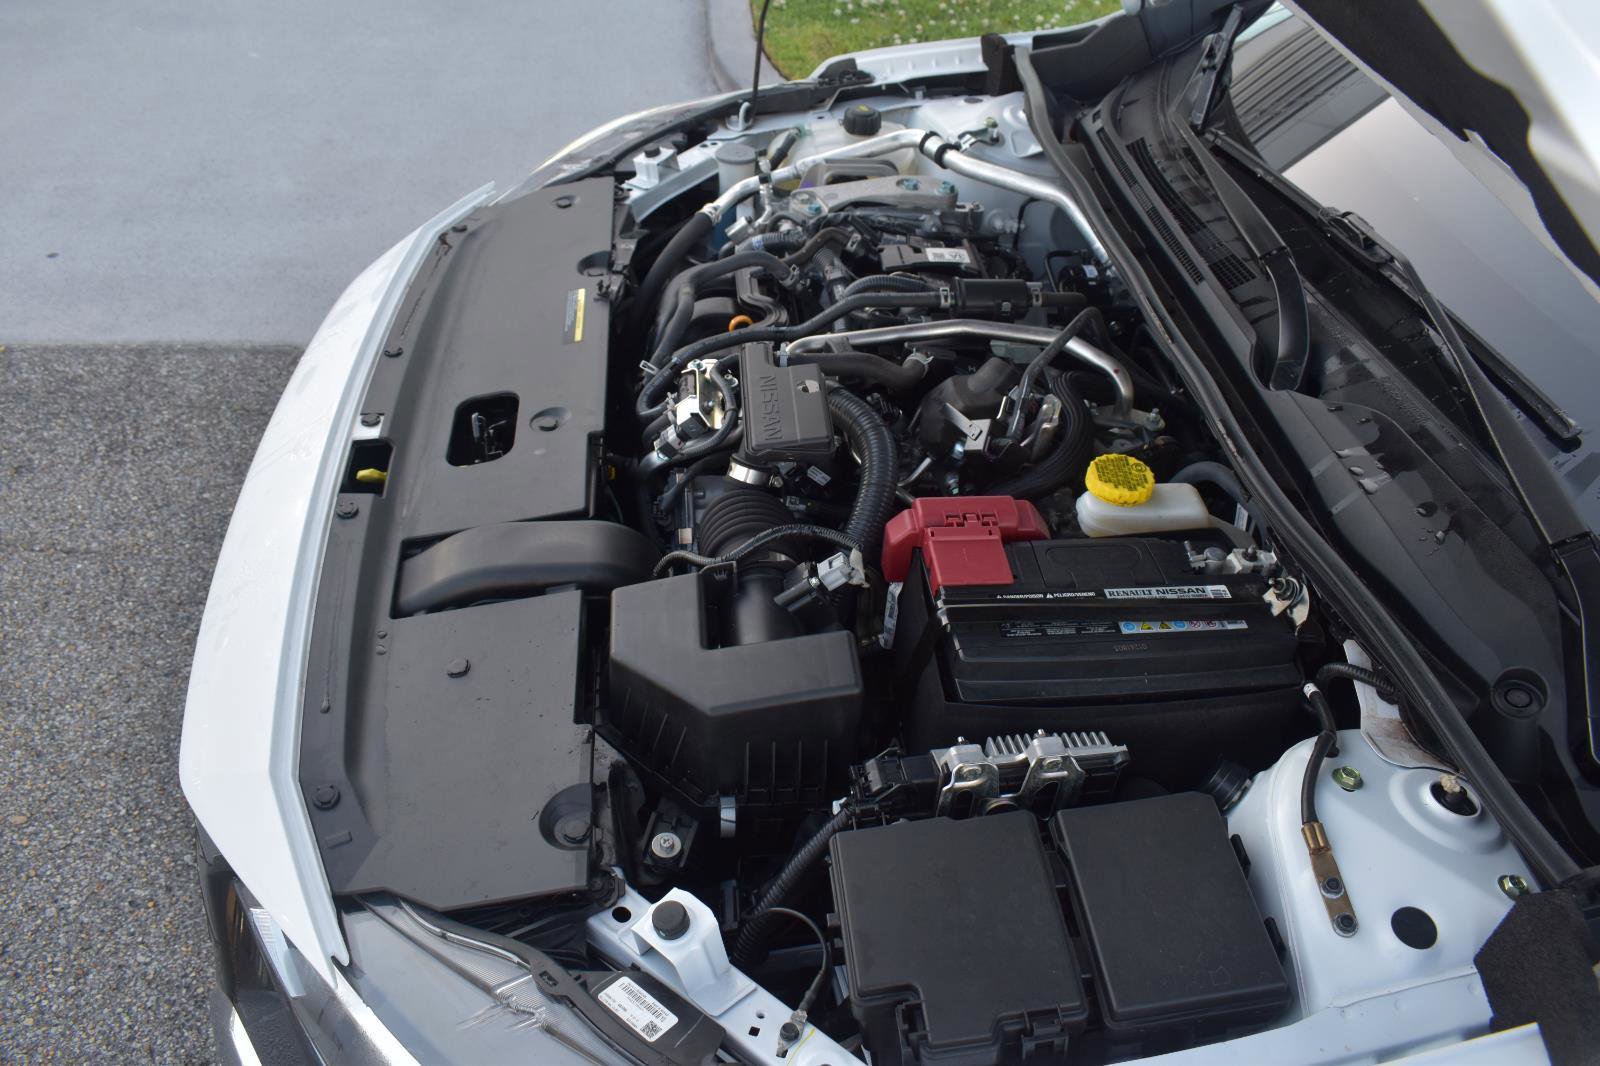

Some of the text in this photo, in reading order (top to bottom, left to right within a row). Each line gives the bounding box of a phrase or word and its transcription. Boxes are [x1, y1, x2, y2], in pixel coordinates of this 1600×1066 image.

[759, 375, 783, 441] NISSAN
[1107, 588, 1153, 598] RENAULT
[1155, 586, 1206, 596] NISSAN
